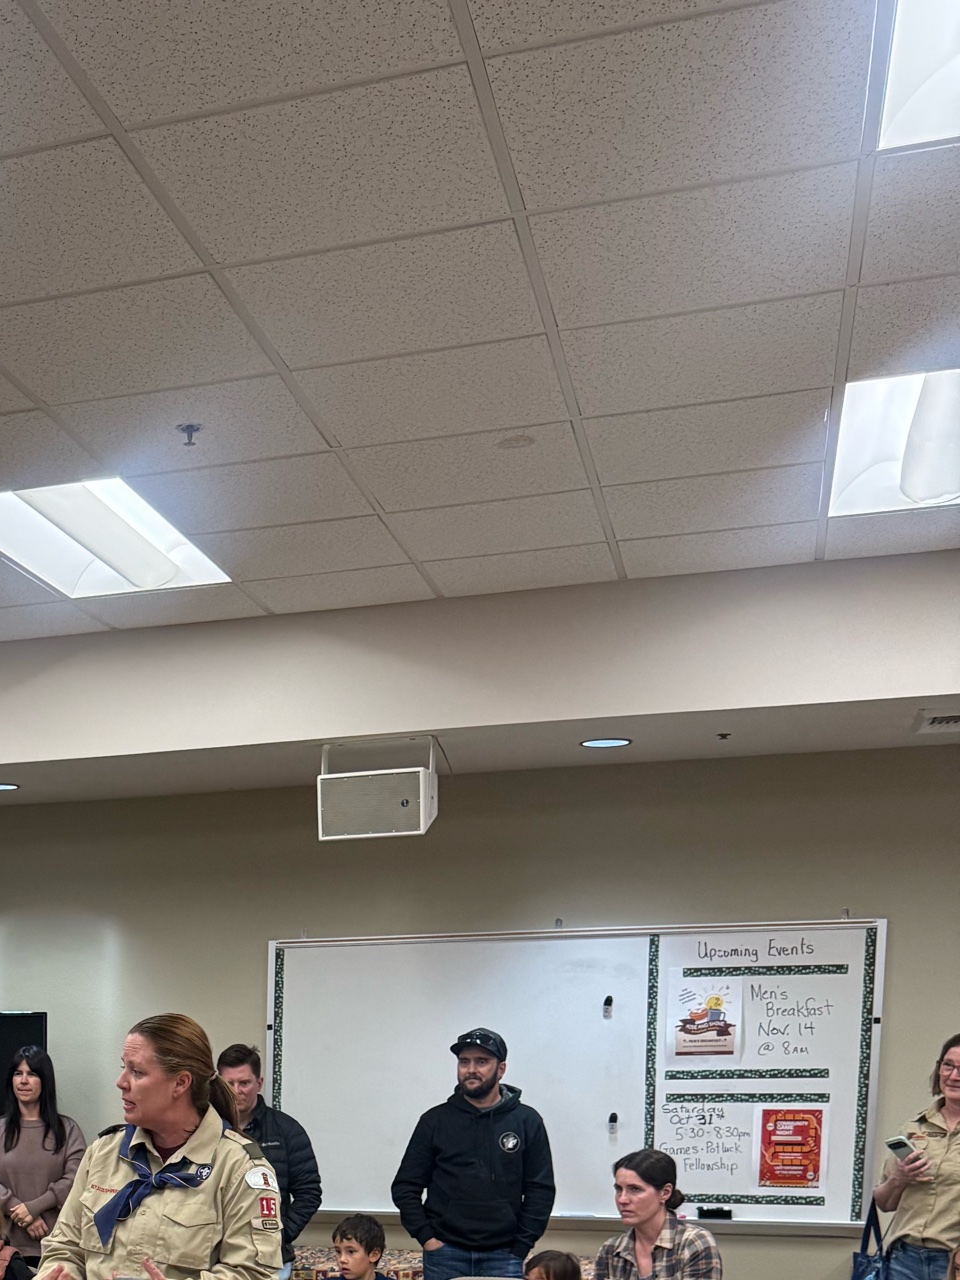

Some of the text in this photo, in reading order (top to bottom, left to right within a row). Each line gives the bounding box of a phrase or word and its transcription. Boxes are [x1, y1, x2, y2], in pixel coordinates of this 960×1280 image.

[698, 937, 814, 962] Upcoming Events
[750, 984, 788, 1001] Men's
[766, 997, 834, 1018] Breakfast
[758, 1020, 816, 1036] Nov. 14
[758, 1042, 774, 1056] @
[661, 1102, 725, 1115] Saturday
[669, 1114, 693, 1125] Oct
[659, 1141, 742, 1155] Games Potluck
[683, 1157, 738, 1176] Fellowship
[262, 1199, 276, 1215] 15
